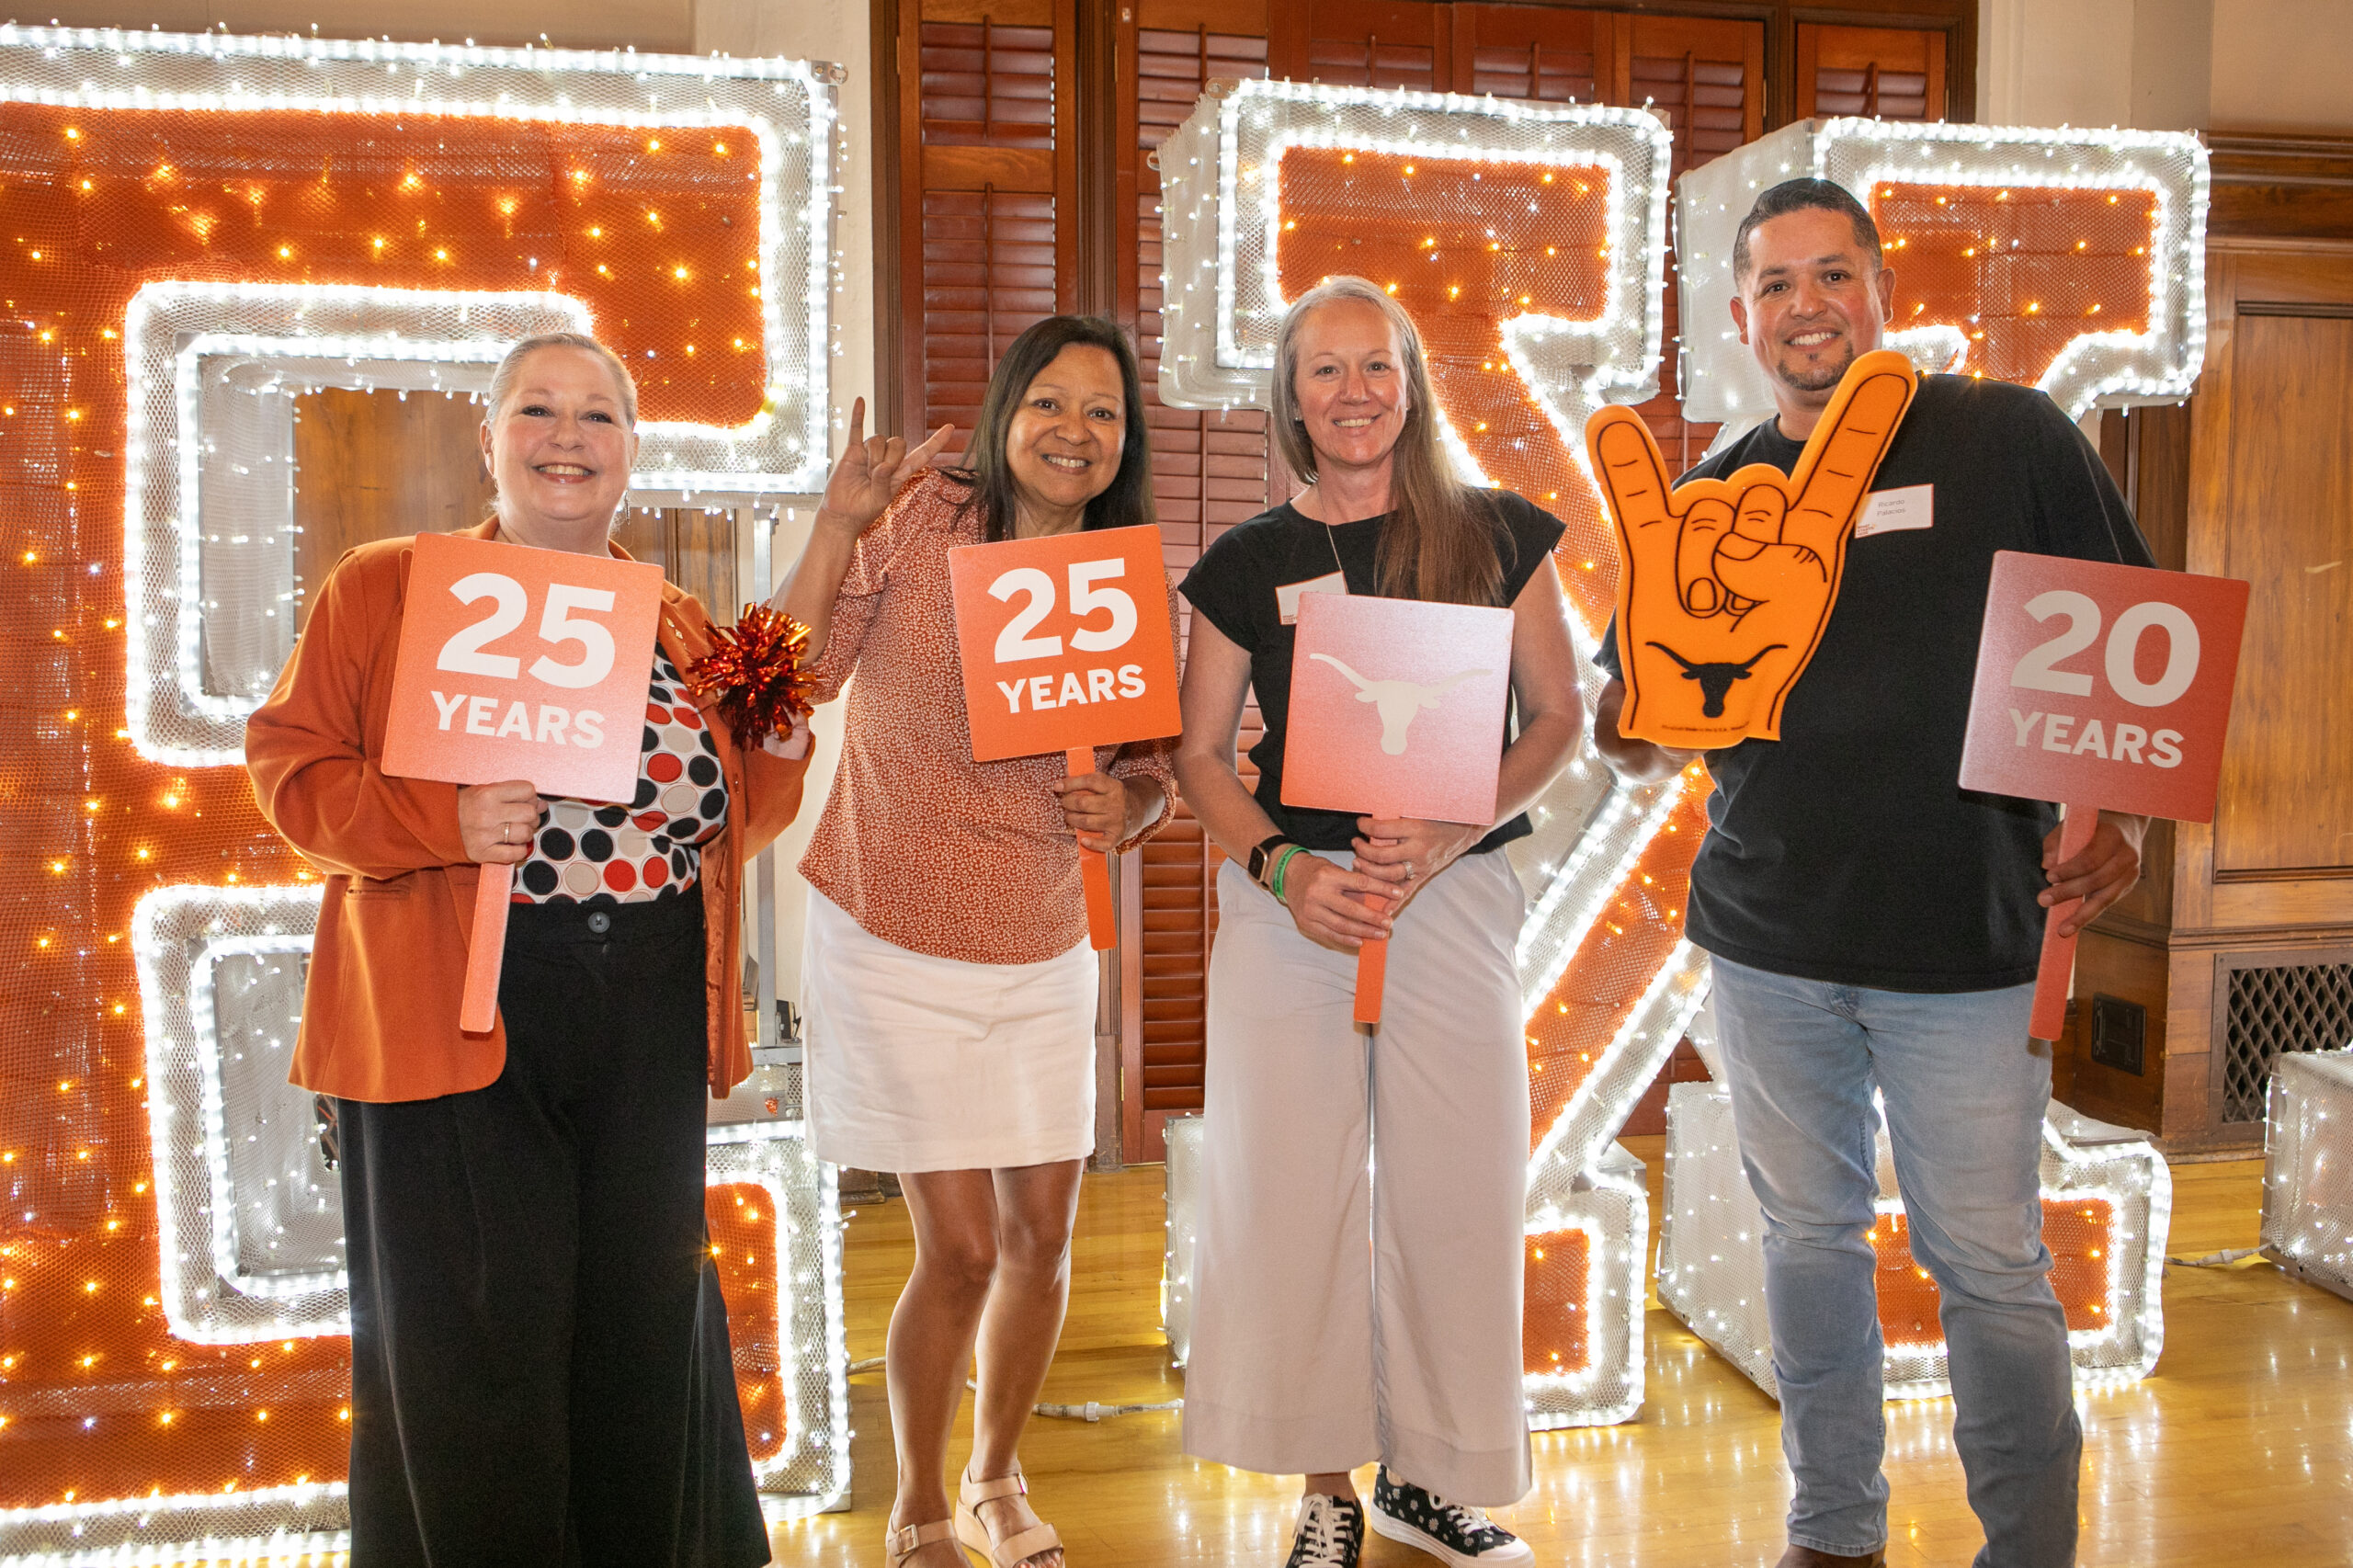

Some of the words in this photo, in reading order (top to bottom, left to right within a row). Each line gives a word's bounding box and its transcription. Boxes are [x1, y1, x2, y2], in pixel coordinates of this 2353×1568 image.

[1878, 499, 1905, 508] Ricardo
[436, 573, 616, 690] 25
[988, 558, 1138, 664] 25
[2010, 589, 2201, 708] 20
[995, 664, 1146, 714] YEARS
[430, 690, 606, 750] YEARS
[2008, 708, 2186, 769] YEARS
